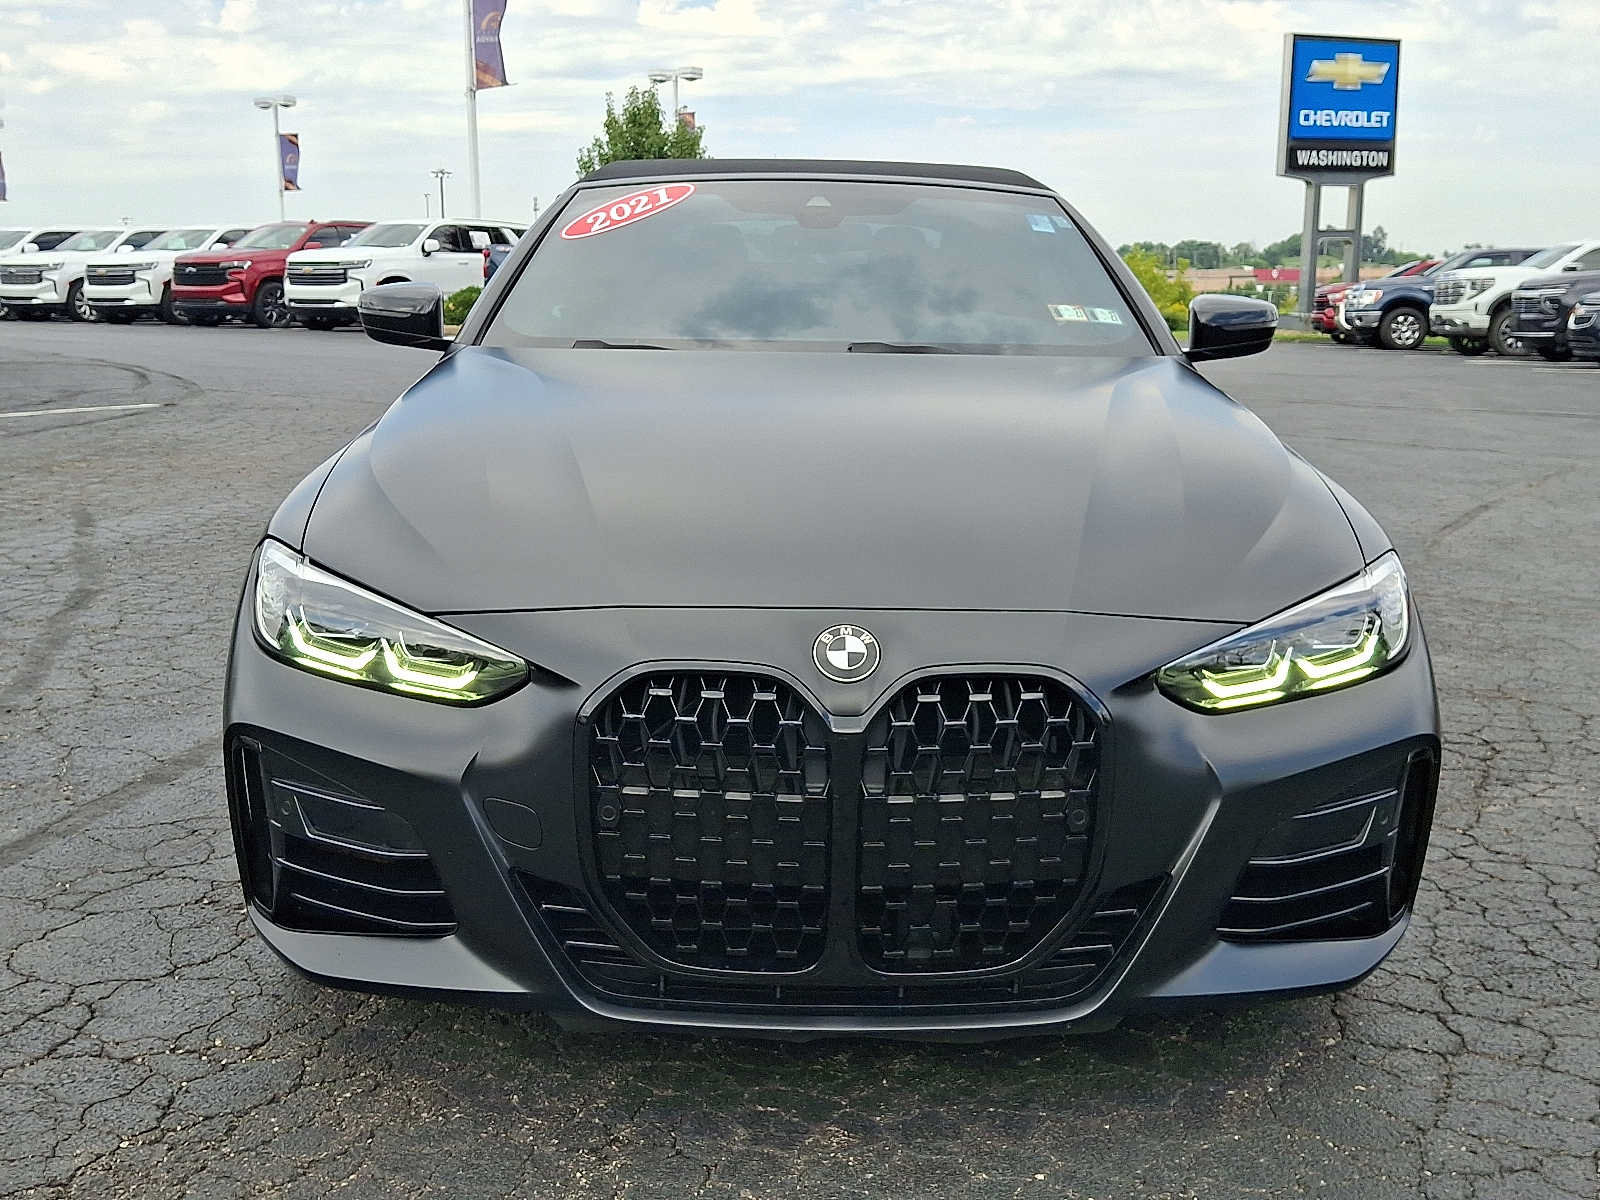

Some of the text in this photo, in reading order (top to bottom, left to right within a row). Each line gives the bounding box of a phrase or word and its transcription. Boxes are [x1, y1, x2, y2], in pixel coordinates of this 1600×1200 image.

[1299, 109, 1391, 128] CHEVROLET
[1296, 149, 1389, 167] WASHINGTON
[586, 188, 673, 233] 2021
[820, 626, 874, 645] BMW
